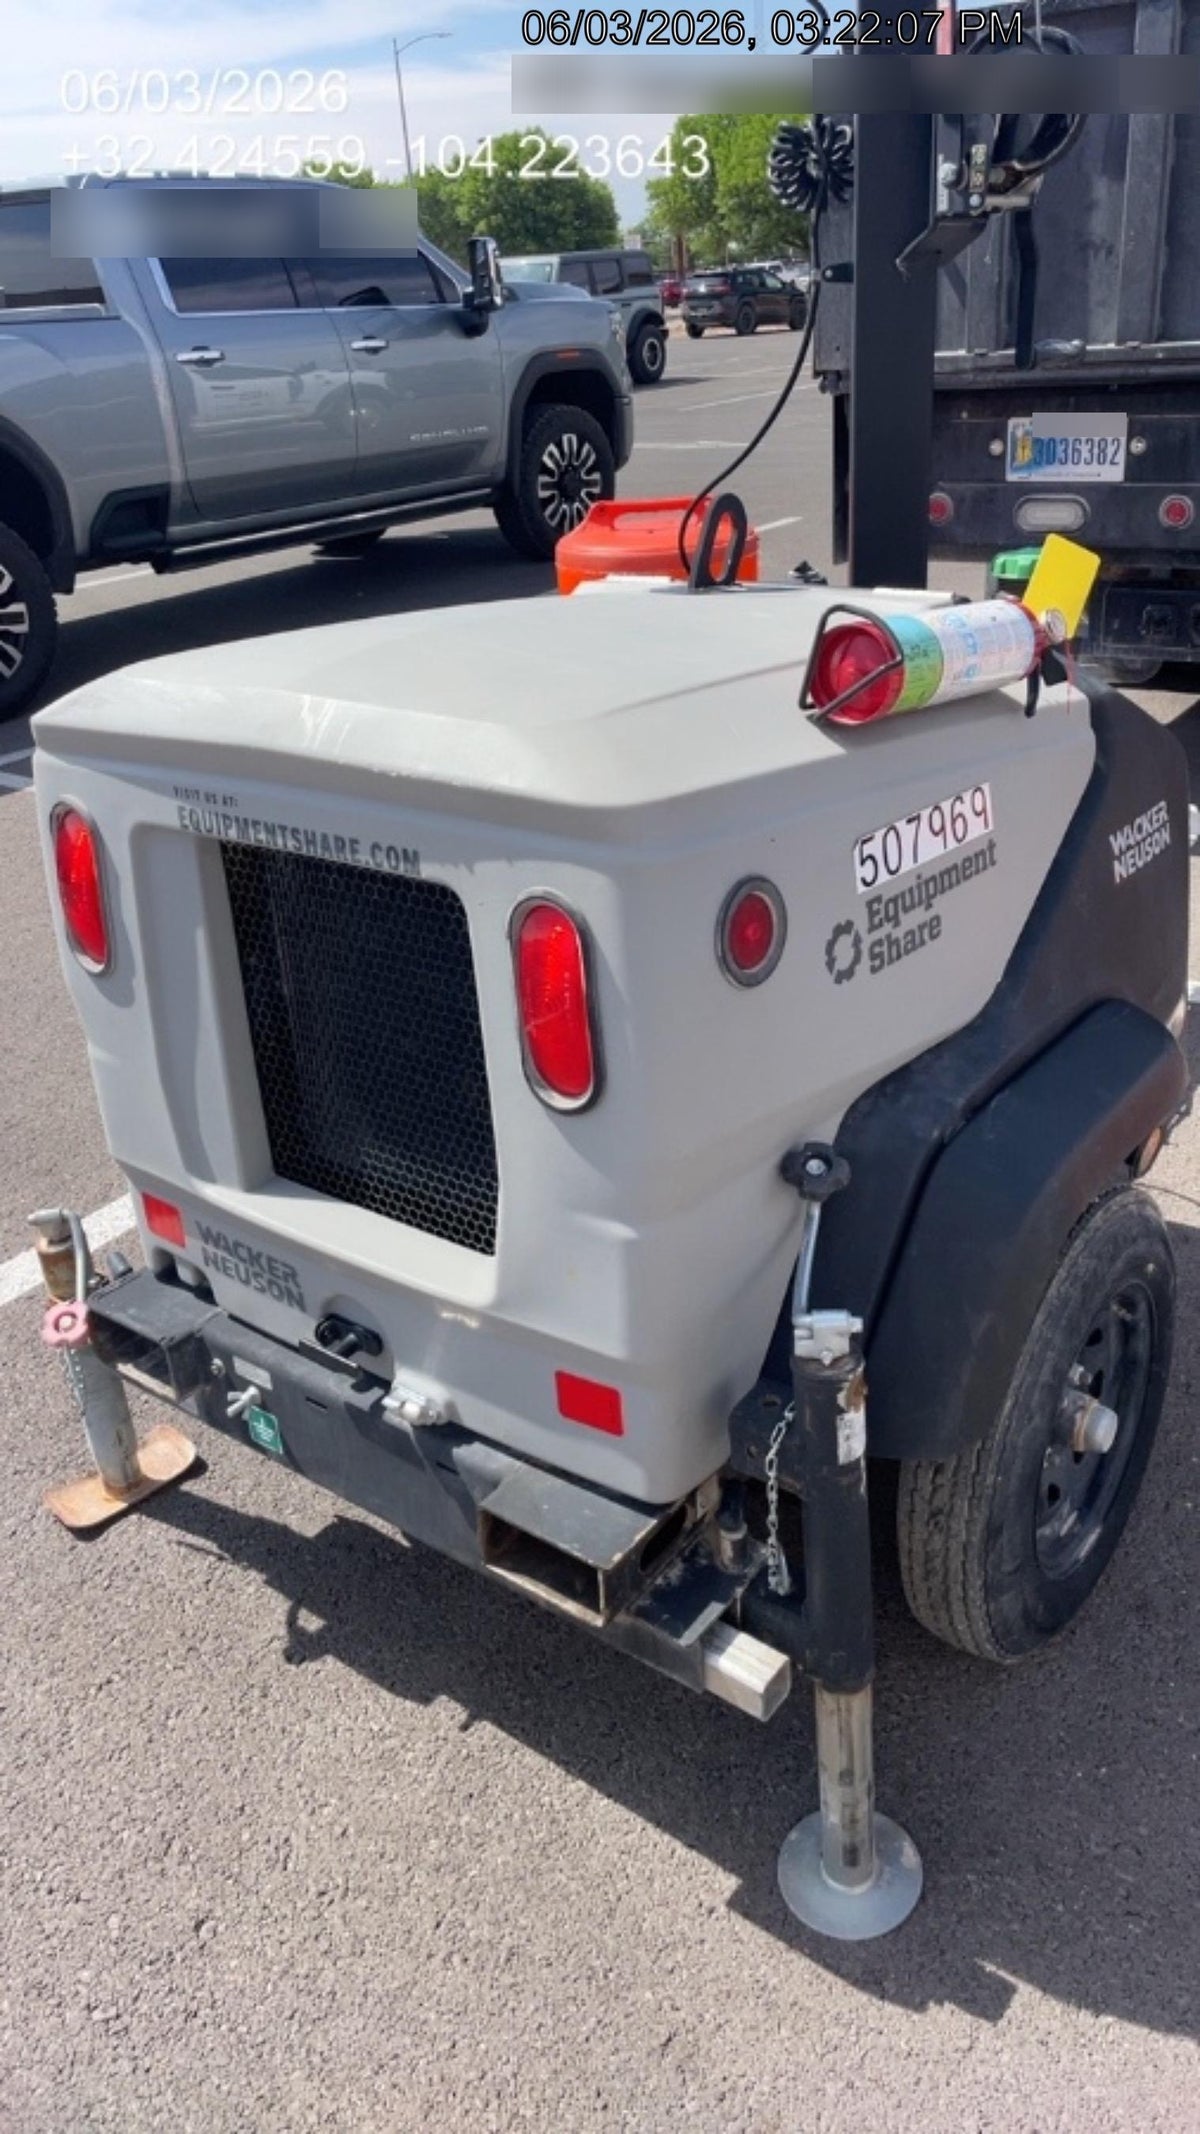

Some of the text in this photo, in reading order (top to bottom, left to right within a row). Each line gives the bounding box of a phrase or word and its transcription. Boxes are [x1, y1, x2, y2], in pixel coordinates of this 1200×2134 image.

[172, 785, 200, 801] VISIT
[203, 791, 217, 805] US
[1109, 800, 1169, 857] WACKER
[177, 804, 421, 877] EQUIPMENTSHARE.COM
[858, 786, 990, 888] 507969
[1113, 822, 1171, 884] NEUSON
[865, 838, 998, 935] Equipment
[868, 914, 943, 976] Share
[194, 1219, 302, 1290] WACKER
[201, 1244, 307, 1314] NEUSON
